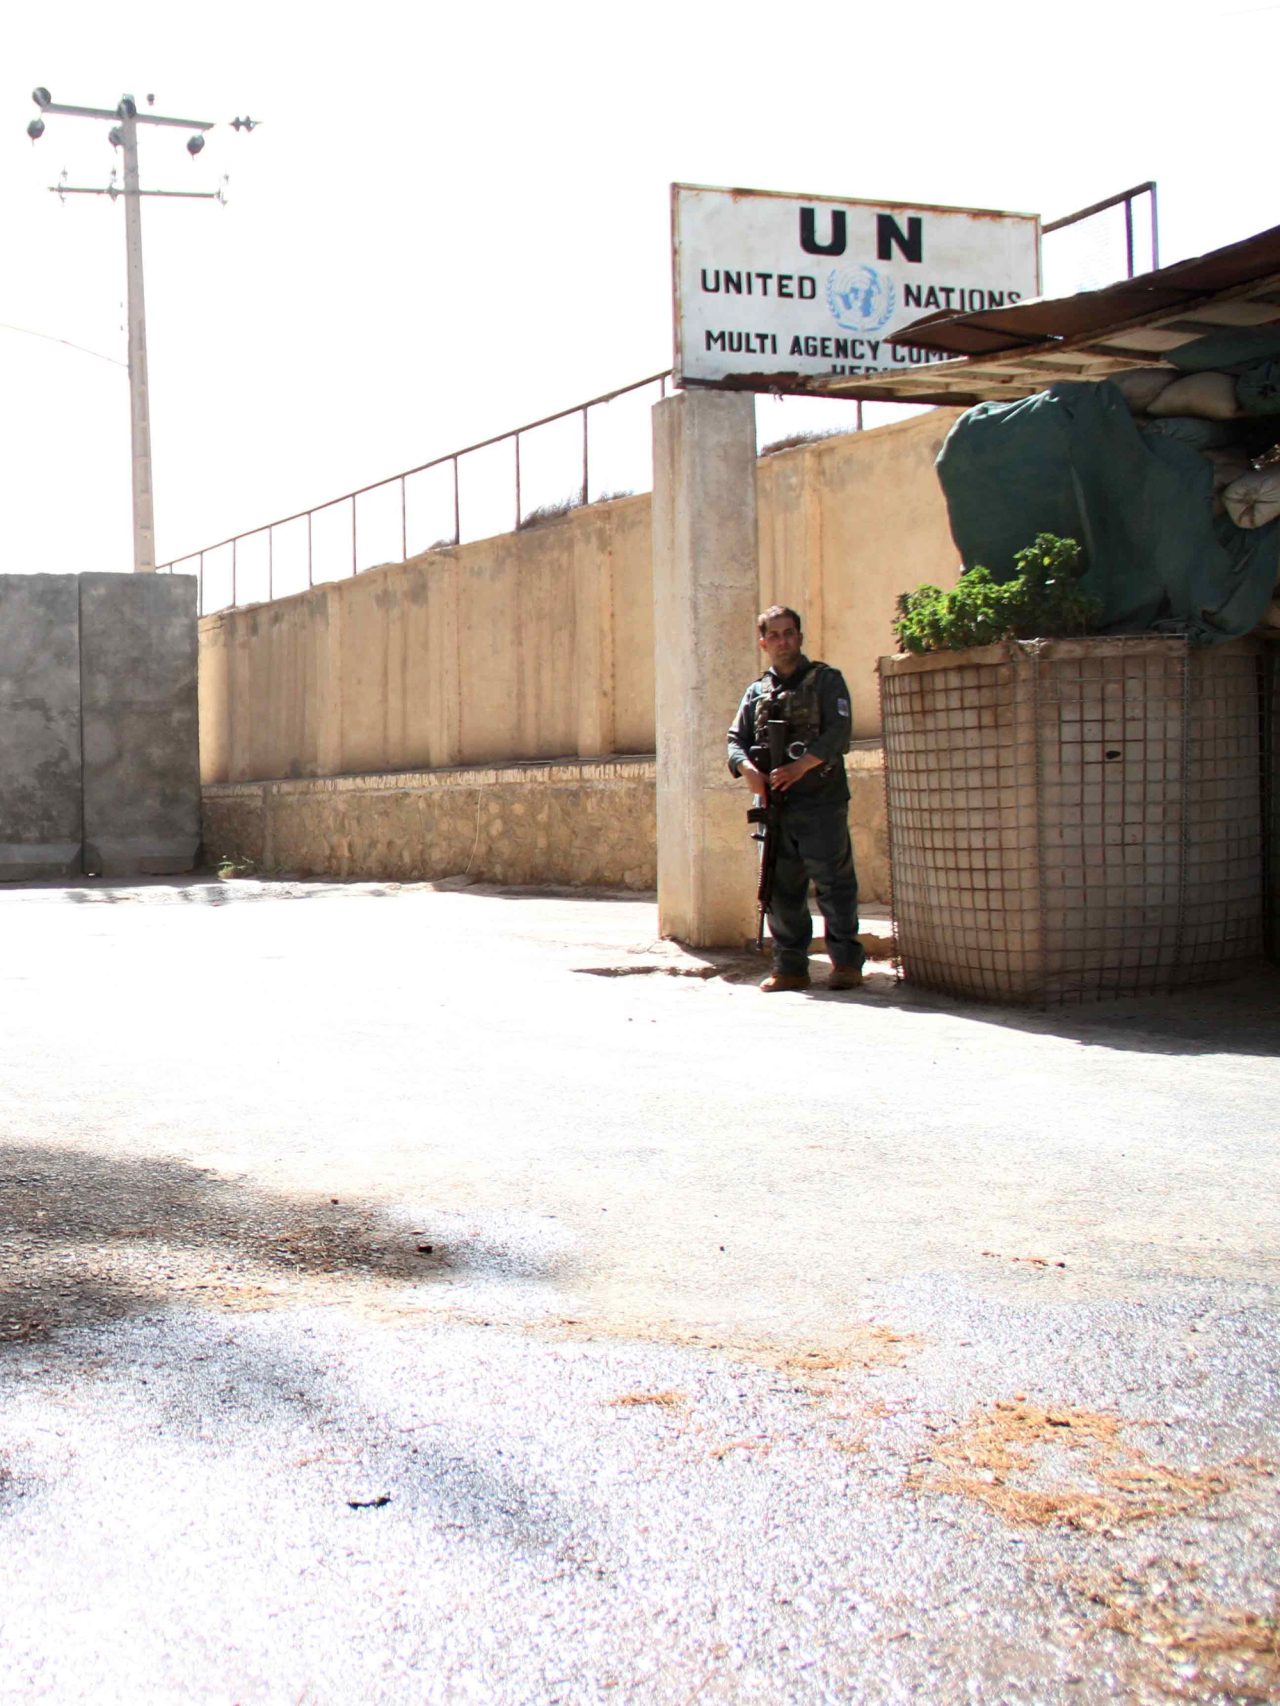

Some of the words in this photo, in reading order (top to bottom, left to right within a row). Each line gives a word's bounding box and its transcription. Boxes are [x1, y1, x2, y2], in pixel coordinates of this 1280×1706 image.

[701, 268, 816, 301] UNITED
[705, 329, 778, 356] MULTI
[789, 334, 881, 362] AGENCY
